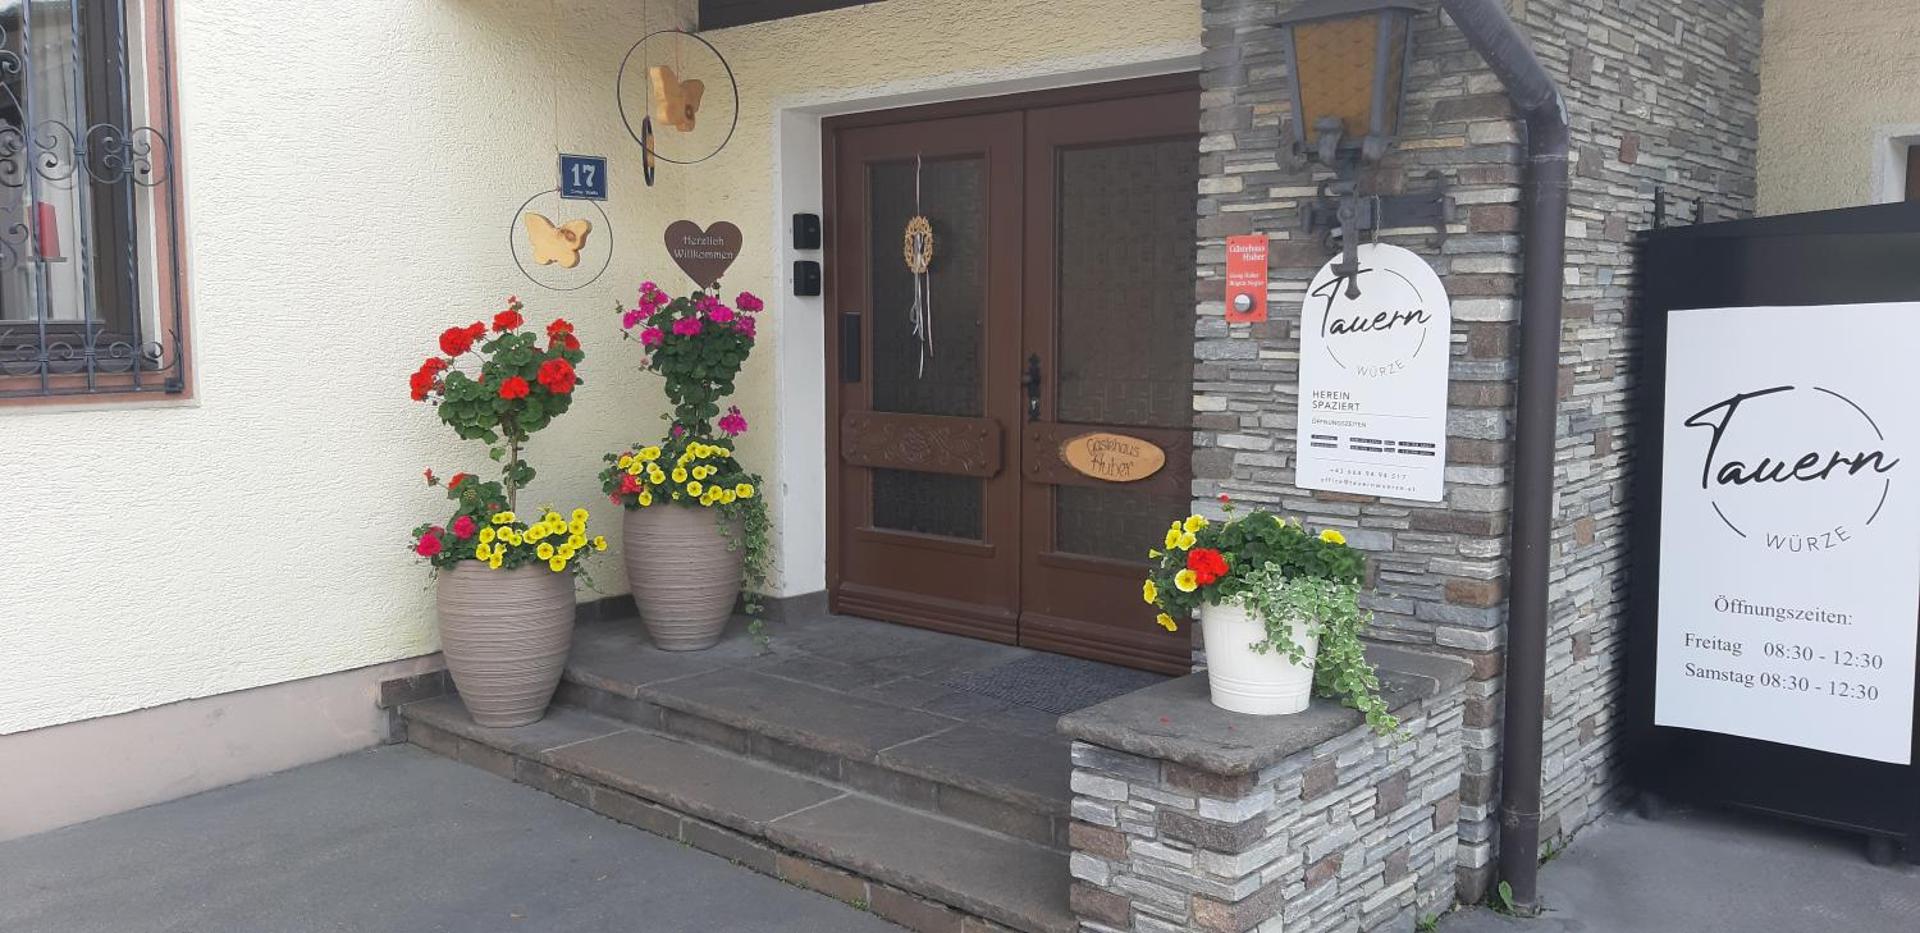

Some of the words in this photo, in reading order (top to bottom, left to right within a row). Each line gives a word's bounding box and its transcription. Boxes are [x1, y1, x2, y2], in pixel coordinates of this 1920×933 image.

[571, 163, 596, 187] 17
[673, 248, 734, 260] Willkommen
[1311, 268, 1431, 338] Tauern
[1312, 400, 1360, 411] SPAZIERT
[1313, 390, 1349, 400] HEREIN
[1684, 385, 1900, 489] Tauern
[1766, 525, 1852, 553] WÜRZE
[1714, 594, 1853, 626] Öffnungszeiten:
[1685, 633, 1743, 657] Freitag
[1763, 641, 1814, 662] 08:30
[1832, 649, 1884, 671] 12:30
[1684, 662, 1756, 689] Samstag
[1759, 671, 1810, 693] 08:30
[1828, 680, 1880, 702] 12:30
